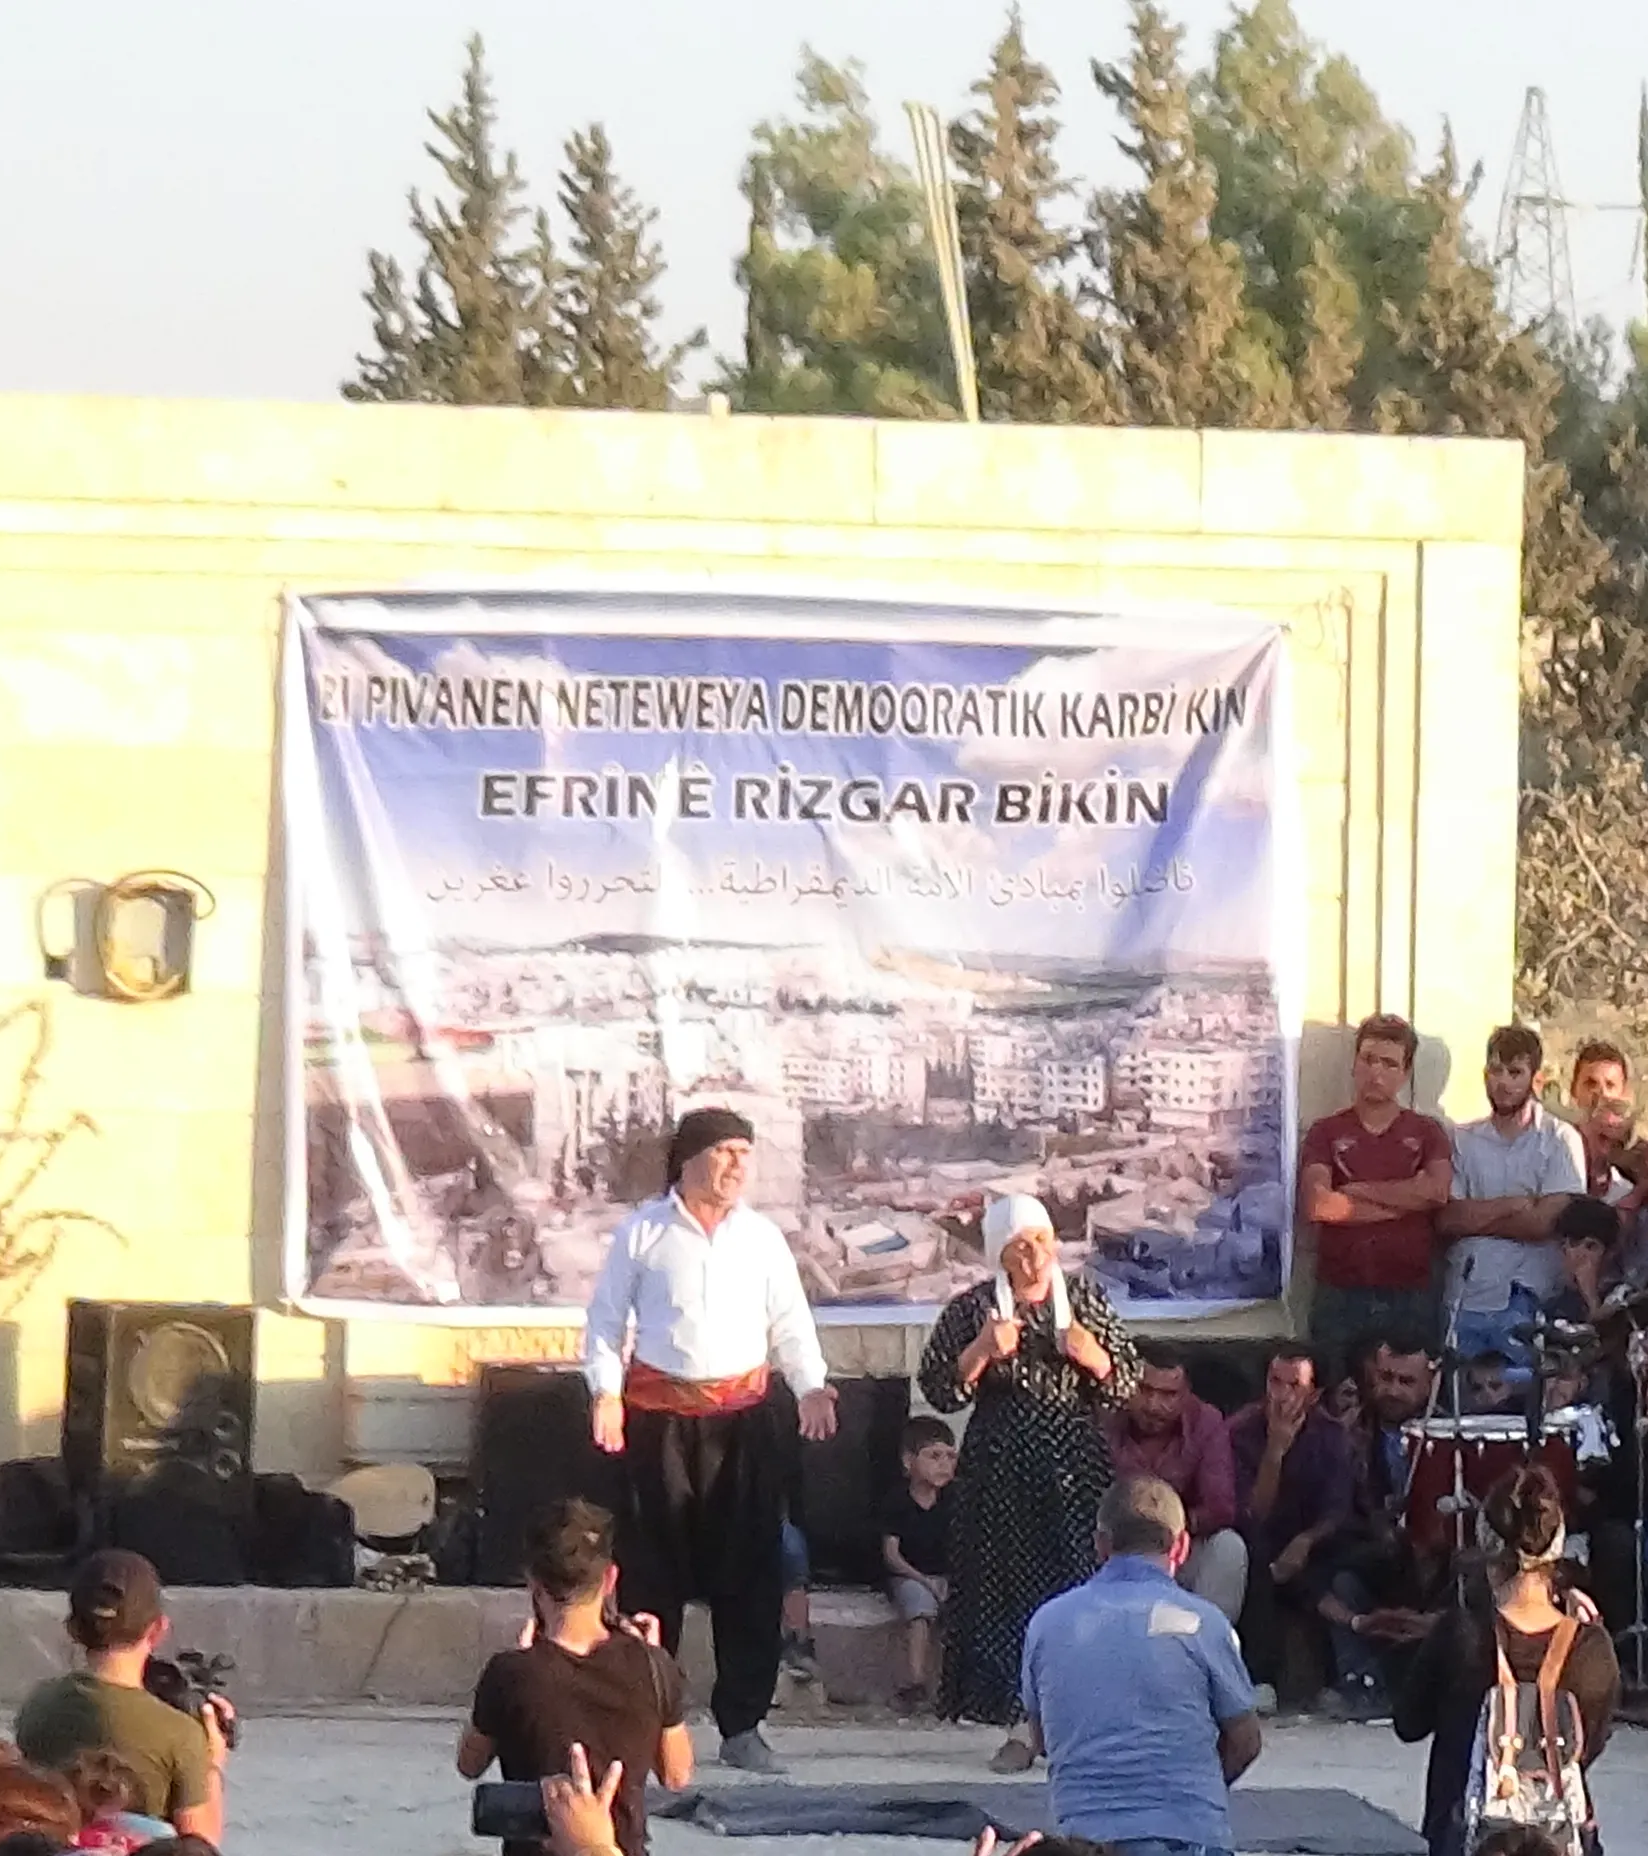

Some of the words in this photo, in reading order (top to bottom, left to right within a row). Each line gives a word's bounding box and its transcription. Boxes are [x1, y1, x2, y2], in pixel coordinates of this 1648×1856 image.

[556, 679, 769, 731] NETEWEYA
[733, 763, 974, 824] RİZGAR
[994, 767, 1169, 824] BİKİN
